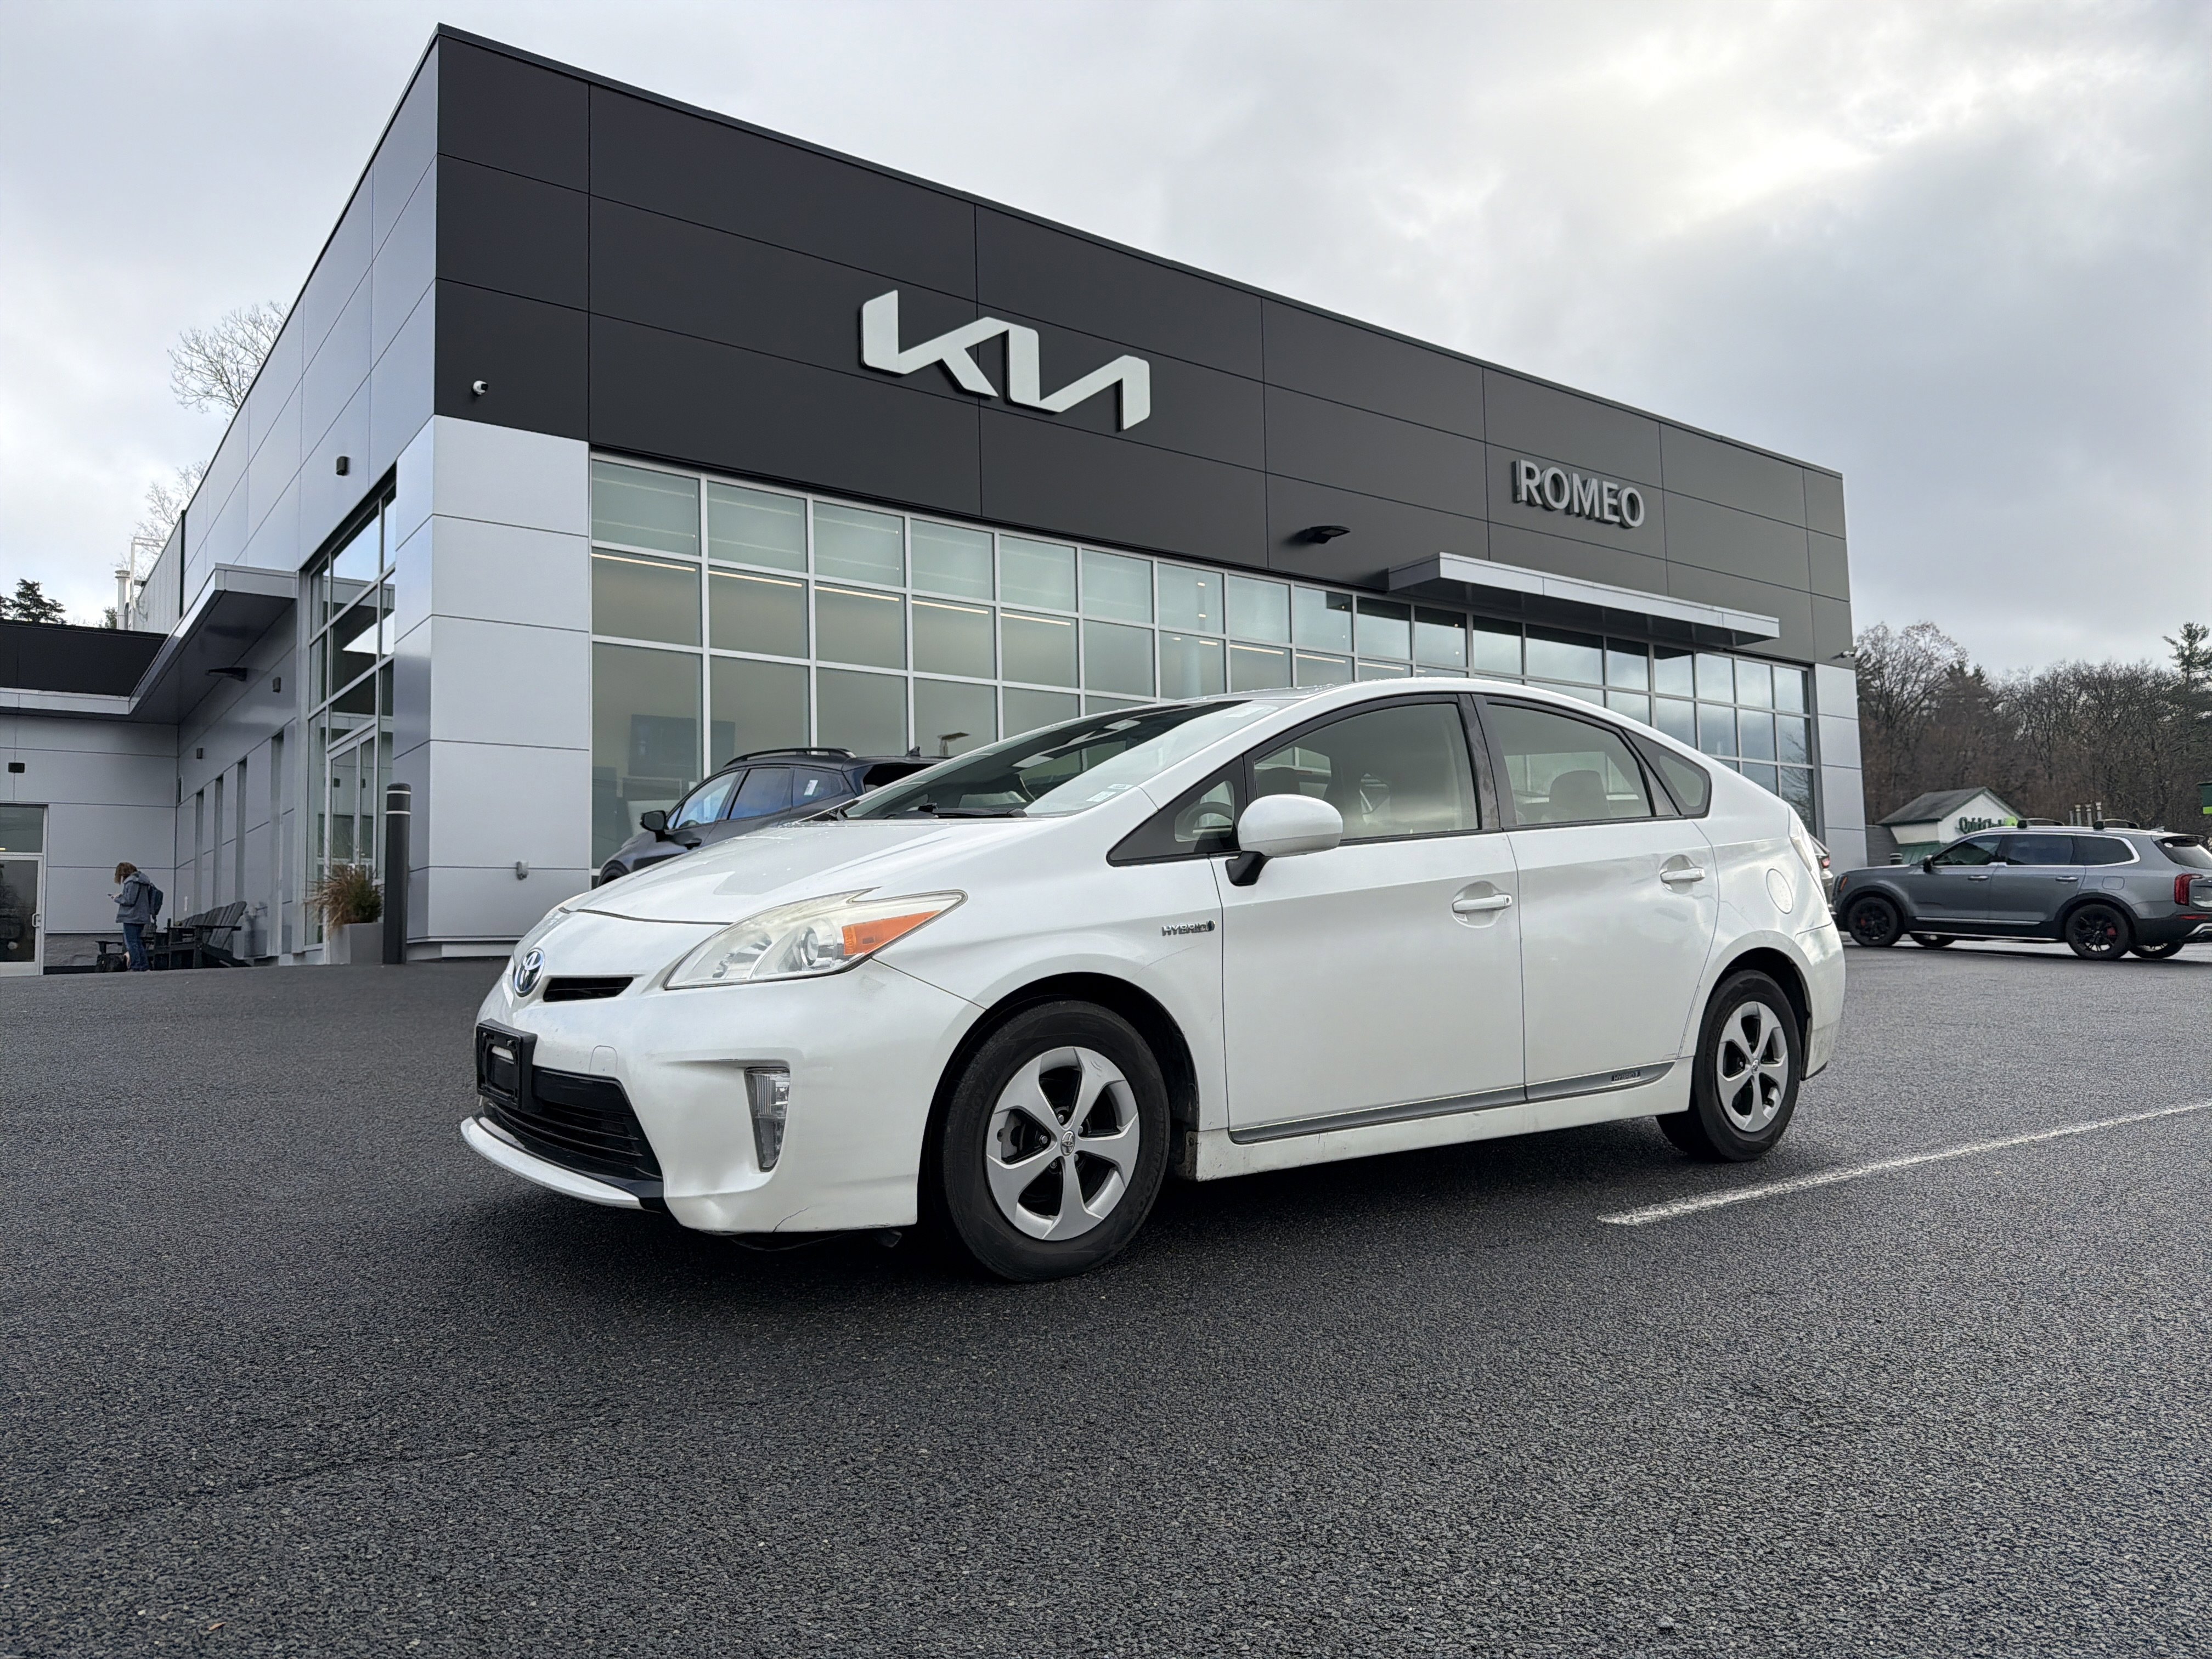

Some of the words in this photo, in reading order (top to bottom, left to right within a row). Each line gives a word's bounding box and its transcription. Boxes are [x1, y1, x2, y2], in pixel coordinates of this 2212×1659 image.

[861, 290, 1150, 431] KIA
[1517, 460, 1645, 528] ROMEO
[1162, 922, 1208, 936] HYBRID
